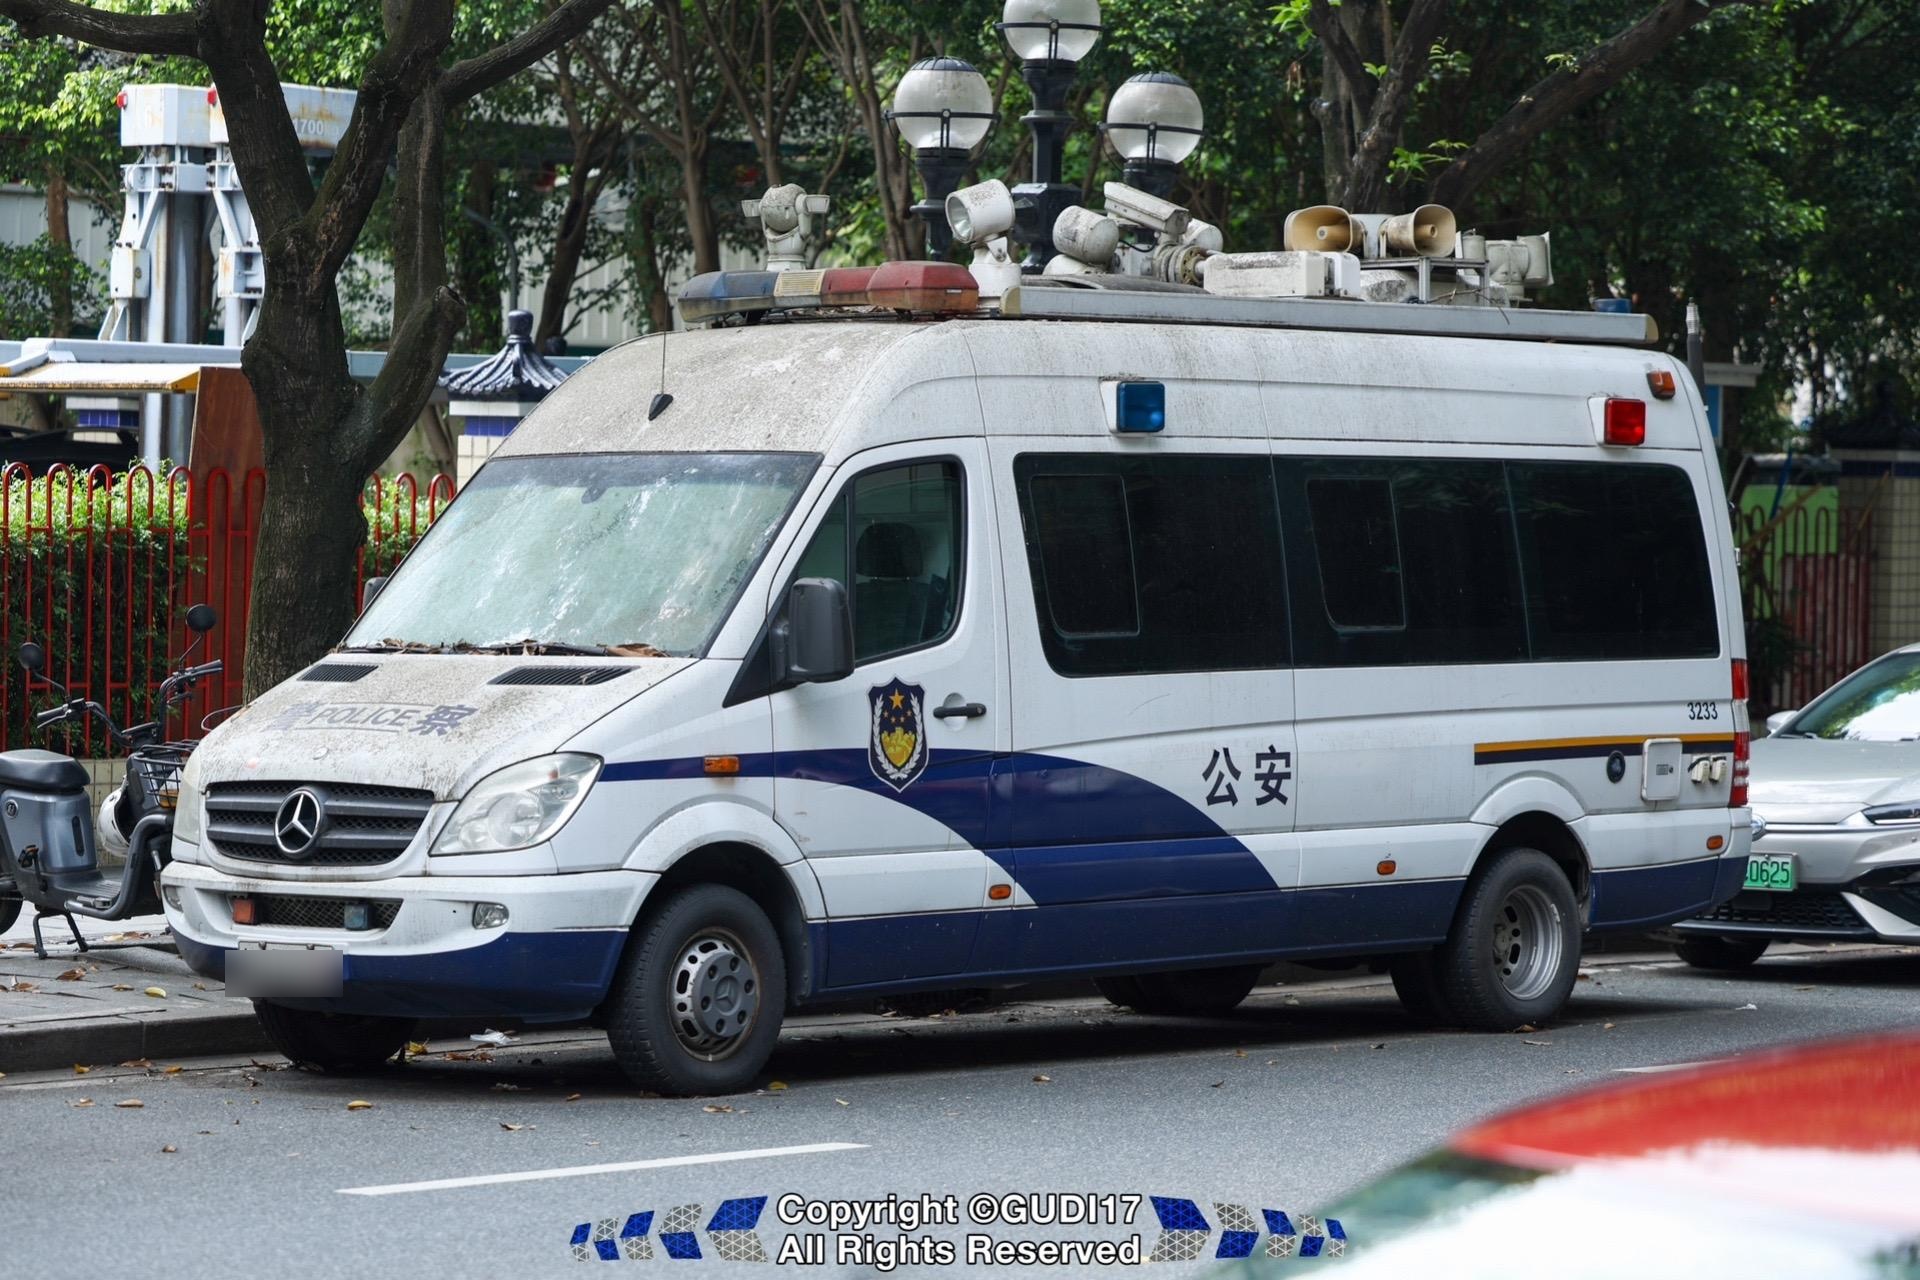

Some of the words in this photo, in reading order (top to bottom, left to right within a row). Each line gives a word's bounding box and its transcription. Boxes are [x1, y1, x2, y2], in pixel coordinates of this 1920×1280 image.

[307, 706, 422, 726] POLICE
[408, 704, 479, 736] 察
[1687, 701, 1718, 720] 3233
[1202, 744, 1291, 807] 公安
[1746, 860, 1790, 883] 0625
